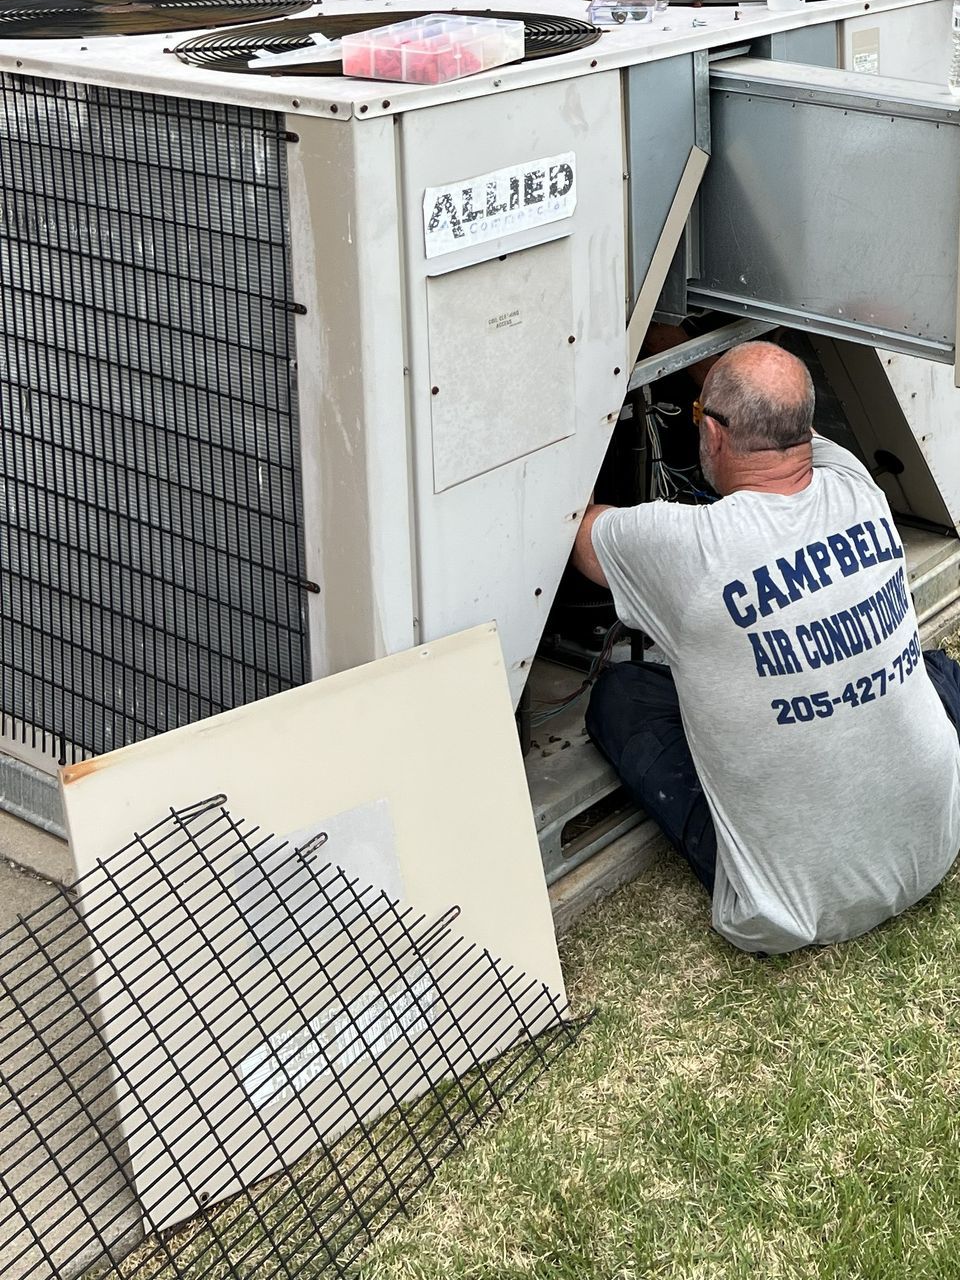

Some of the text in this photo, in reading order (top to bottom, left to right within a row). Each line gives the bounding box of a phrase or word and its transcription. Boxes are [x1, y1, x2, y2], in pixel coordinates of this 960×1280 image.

[427, 163, 574, 239] ALLIED
[722, 518, 904, 629] CAMPBELL
[748, 566, 909, 677] AIR CONDITIONING
